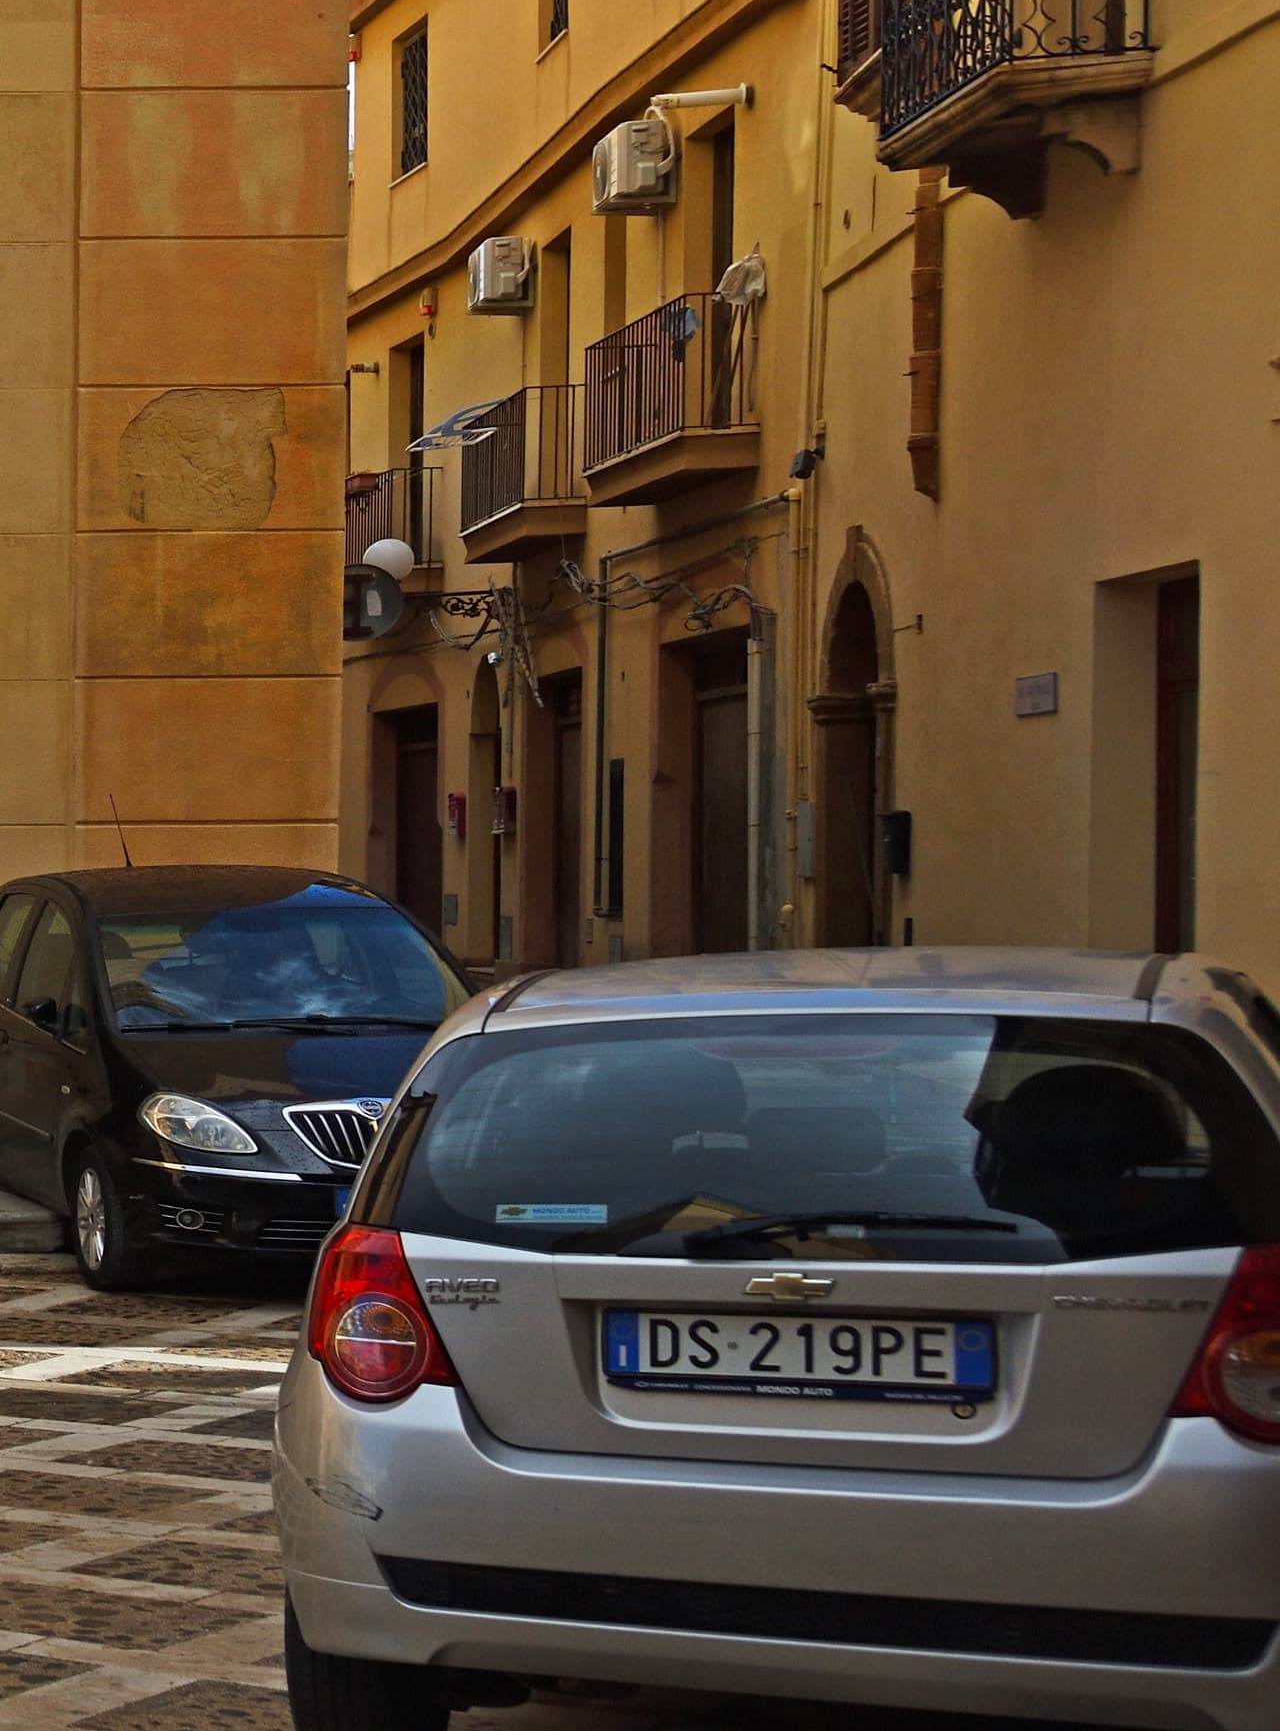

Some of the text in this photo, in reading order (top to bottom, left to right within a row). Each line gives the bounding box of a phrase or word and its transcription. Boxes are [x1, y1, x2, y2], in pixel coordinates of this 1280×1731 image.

[425, 1278, 499, 1293] AVEO
[649, 1319, 947, 1379] DS 219PE
[756, 1385, 800, 1395] MONDO
[802, 1387, 834, 1396] AUTO
